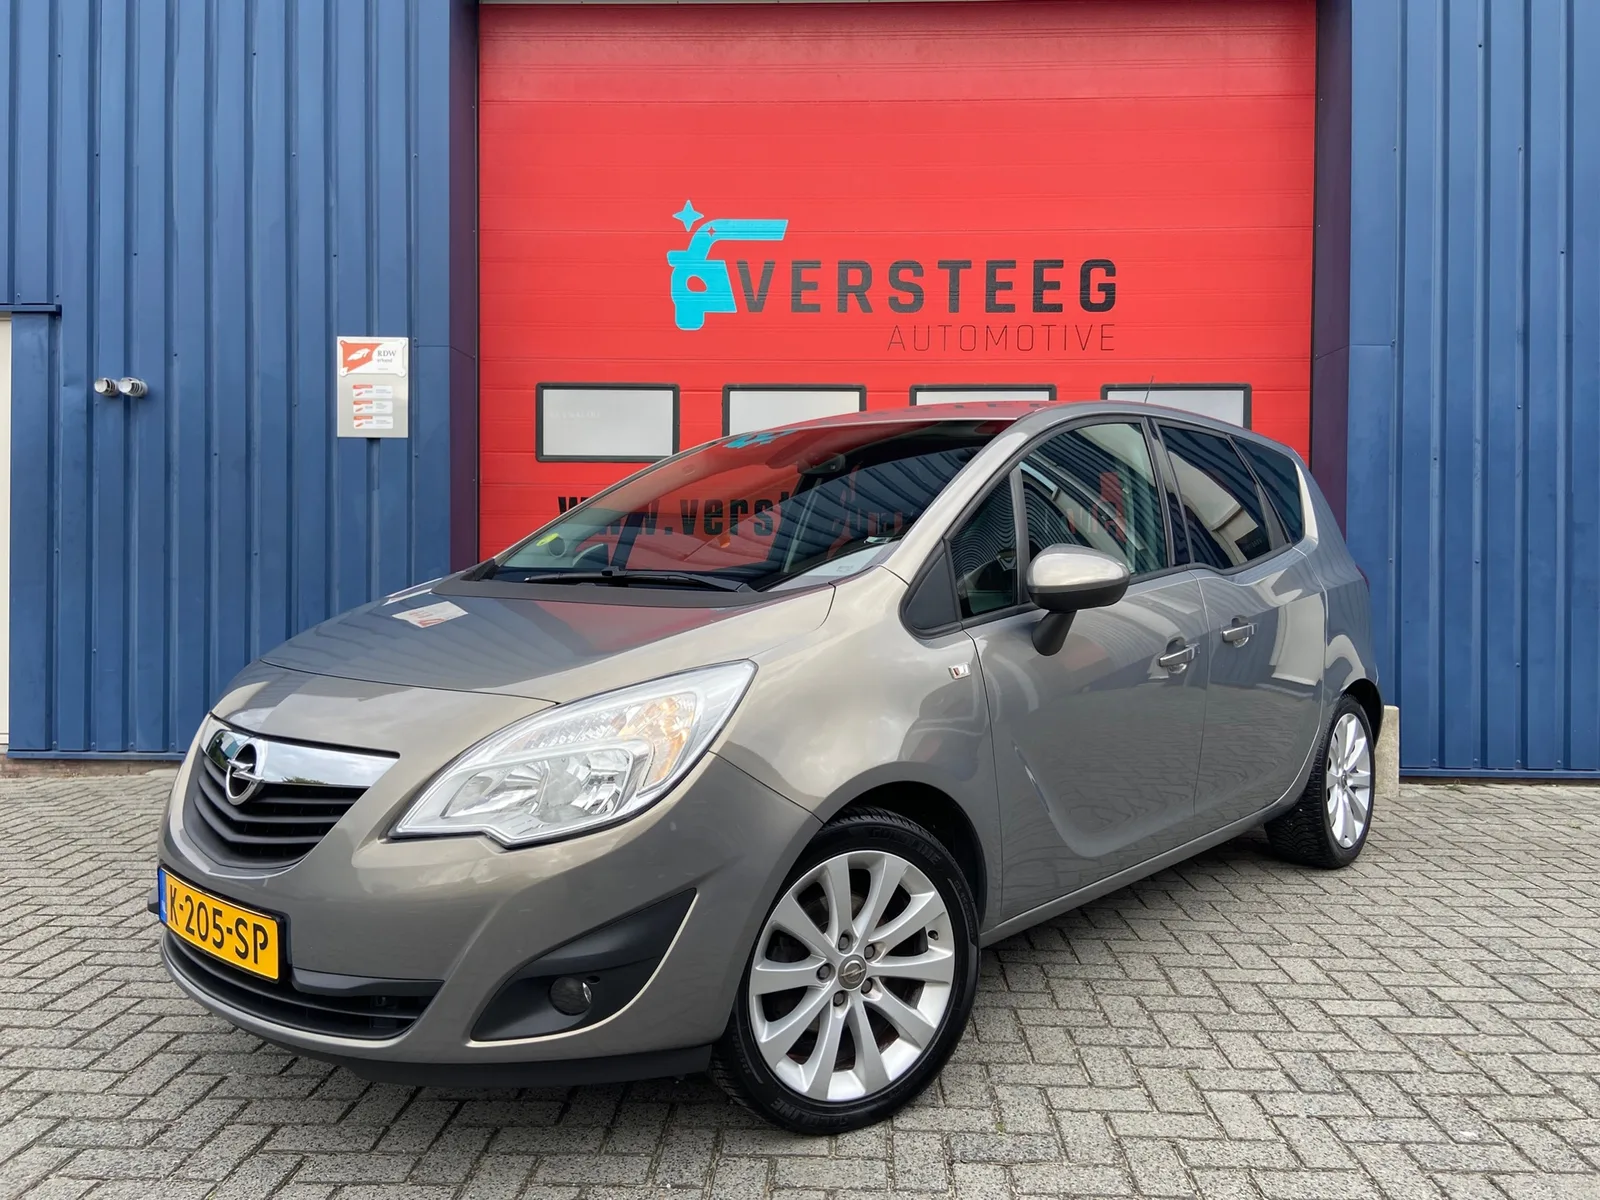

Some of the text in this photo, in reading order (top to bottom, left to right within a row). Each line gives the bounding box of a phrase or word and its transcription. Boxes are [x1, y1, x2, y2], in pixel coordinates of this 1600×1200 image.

[736, 258, 1116, 313] VERSTEEG
[887, 324, 1115, 352] AUTOMOTIVE
[169, 884, 269, 965] K-205-SP
